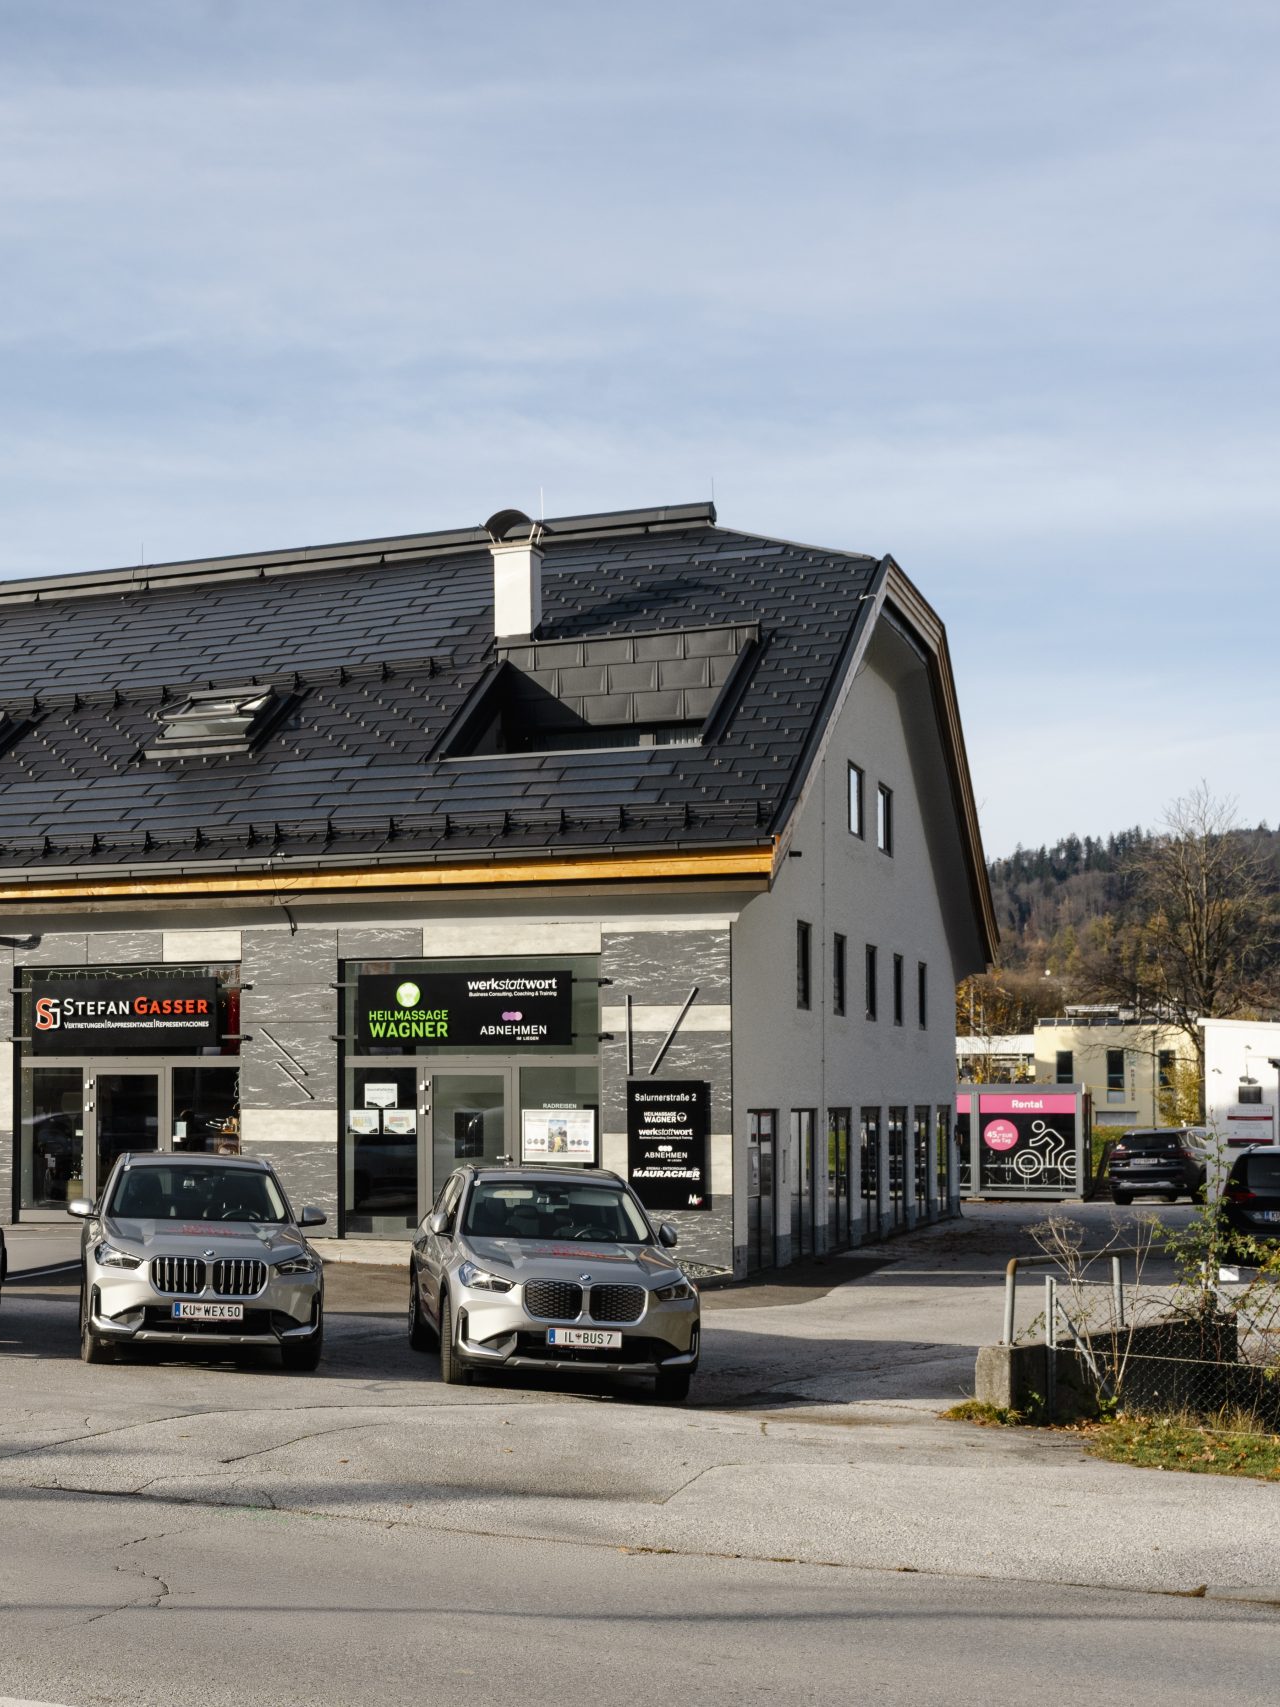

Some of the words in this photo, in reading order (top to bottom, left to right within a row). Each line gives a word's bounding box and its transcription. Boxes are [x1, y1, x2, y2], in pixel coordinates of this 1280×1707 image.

[467, 977, 558, 990] werkstattwort
[63, 998, 130, 1016] STEFAN
[133, 996, 208, 1015] GASSER
[368, 1009, 449, 1021] HEILMASSAGE
[369, 1021, 449, 1038] WAGNER
[480, 1025, 547, 1035] ABNEHMEN
[634, 1092, 690, 1102] Salurnerstraße
[691, 1093, 697, 1102] 2
[1011, 1099, 1043, 1109] Rental
[644, 1151, 688, 1159] ABNEHMEN
[632, 1170, 701, 1178] MAURACHER
[182, 1305, 196, 1316] KU
[203, 1306, 225, 1317] WEX
[227, 1306, 240, 1318] 50
[564, 1331, 574, 1343] IL
[582, 1332, 604, 1345] BUS
[606, 1333, 613, 1345] 7
